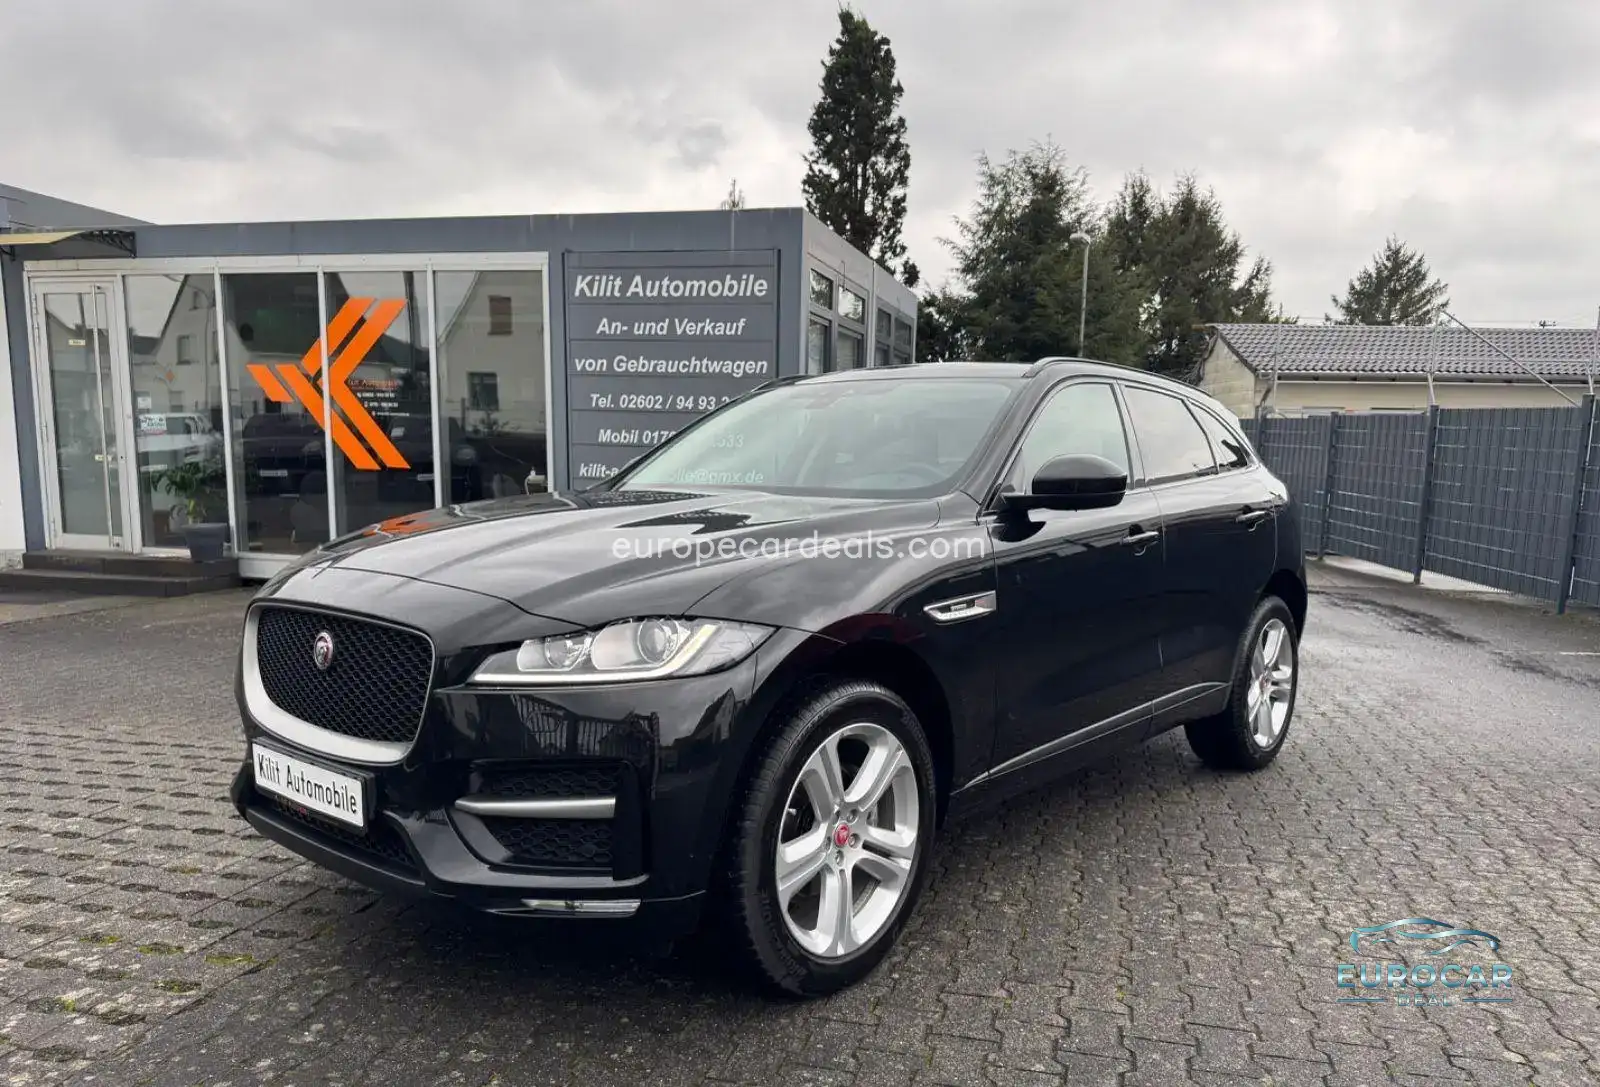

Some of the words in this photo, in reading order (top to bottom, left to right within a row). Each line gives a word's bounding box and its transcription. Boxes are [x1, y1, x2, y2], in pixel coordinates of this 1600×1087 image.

[574, 274, 623, 298] Kilit
[626, 273, 768, 298] Automobile
[596, 317, 628, 335] An-
[633, 318, 670, 336] und
[674, 317, 747, 336] Verkauf
[574, 358, 608, 372] von
[613, 354, 768, 378] Gebrauchtwagen
[589, 393, 615, 409] Tel.
[619, 394, 663, 410] 02602
[666, 394, 674, 409] /
[676, 395, 694, 410] 94
[698, 395, 716, 410] 93
[598, 428, 640, 444] Mobil
[257, 752, 281, 785] Kilit
[286, 764, 358, 815] Automobile
